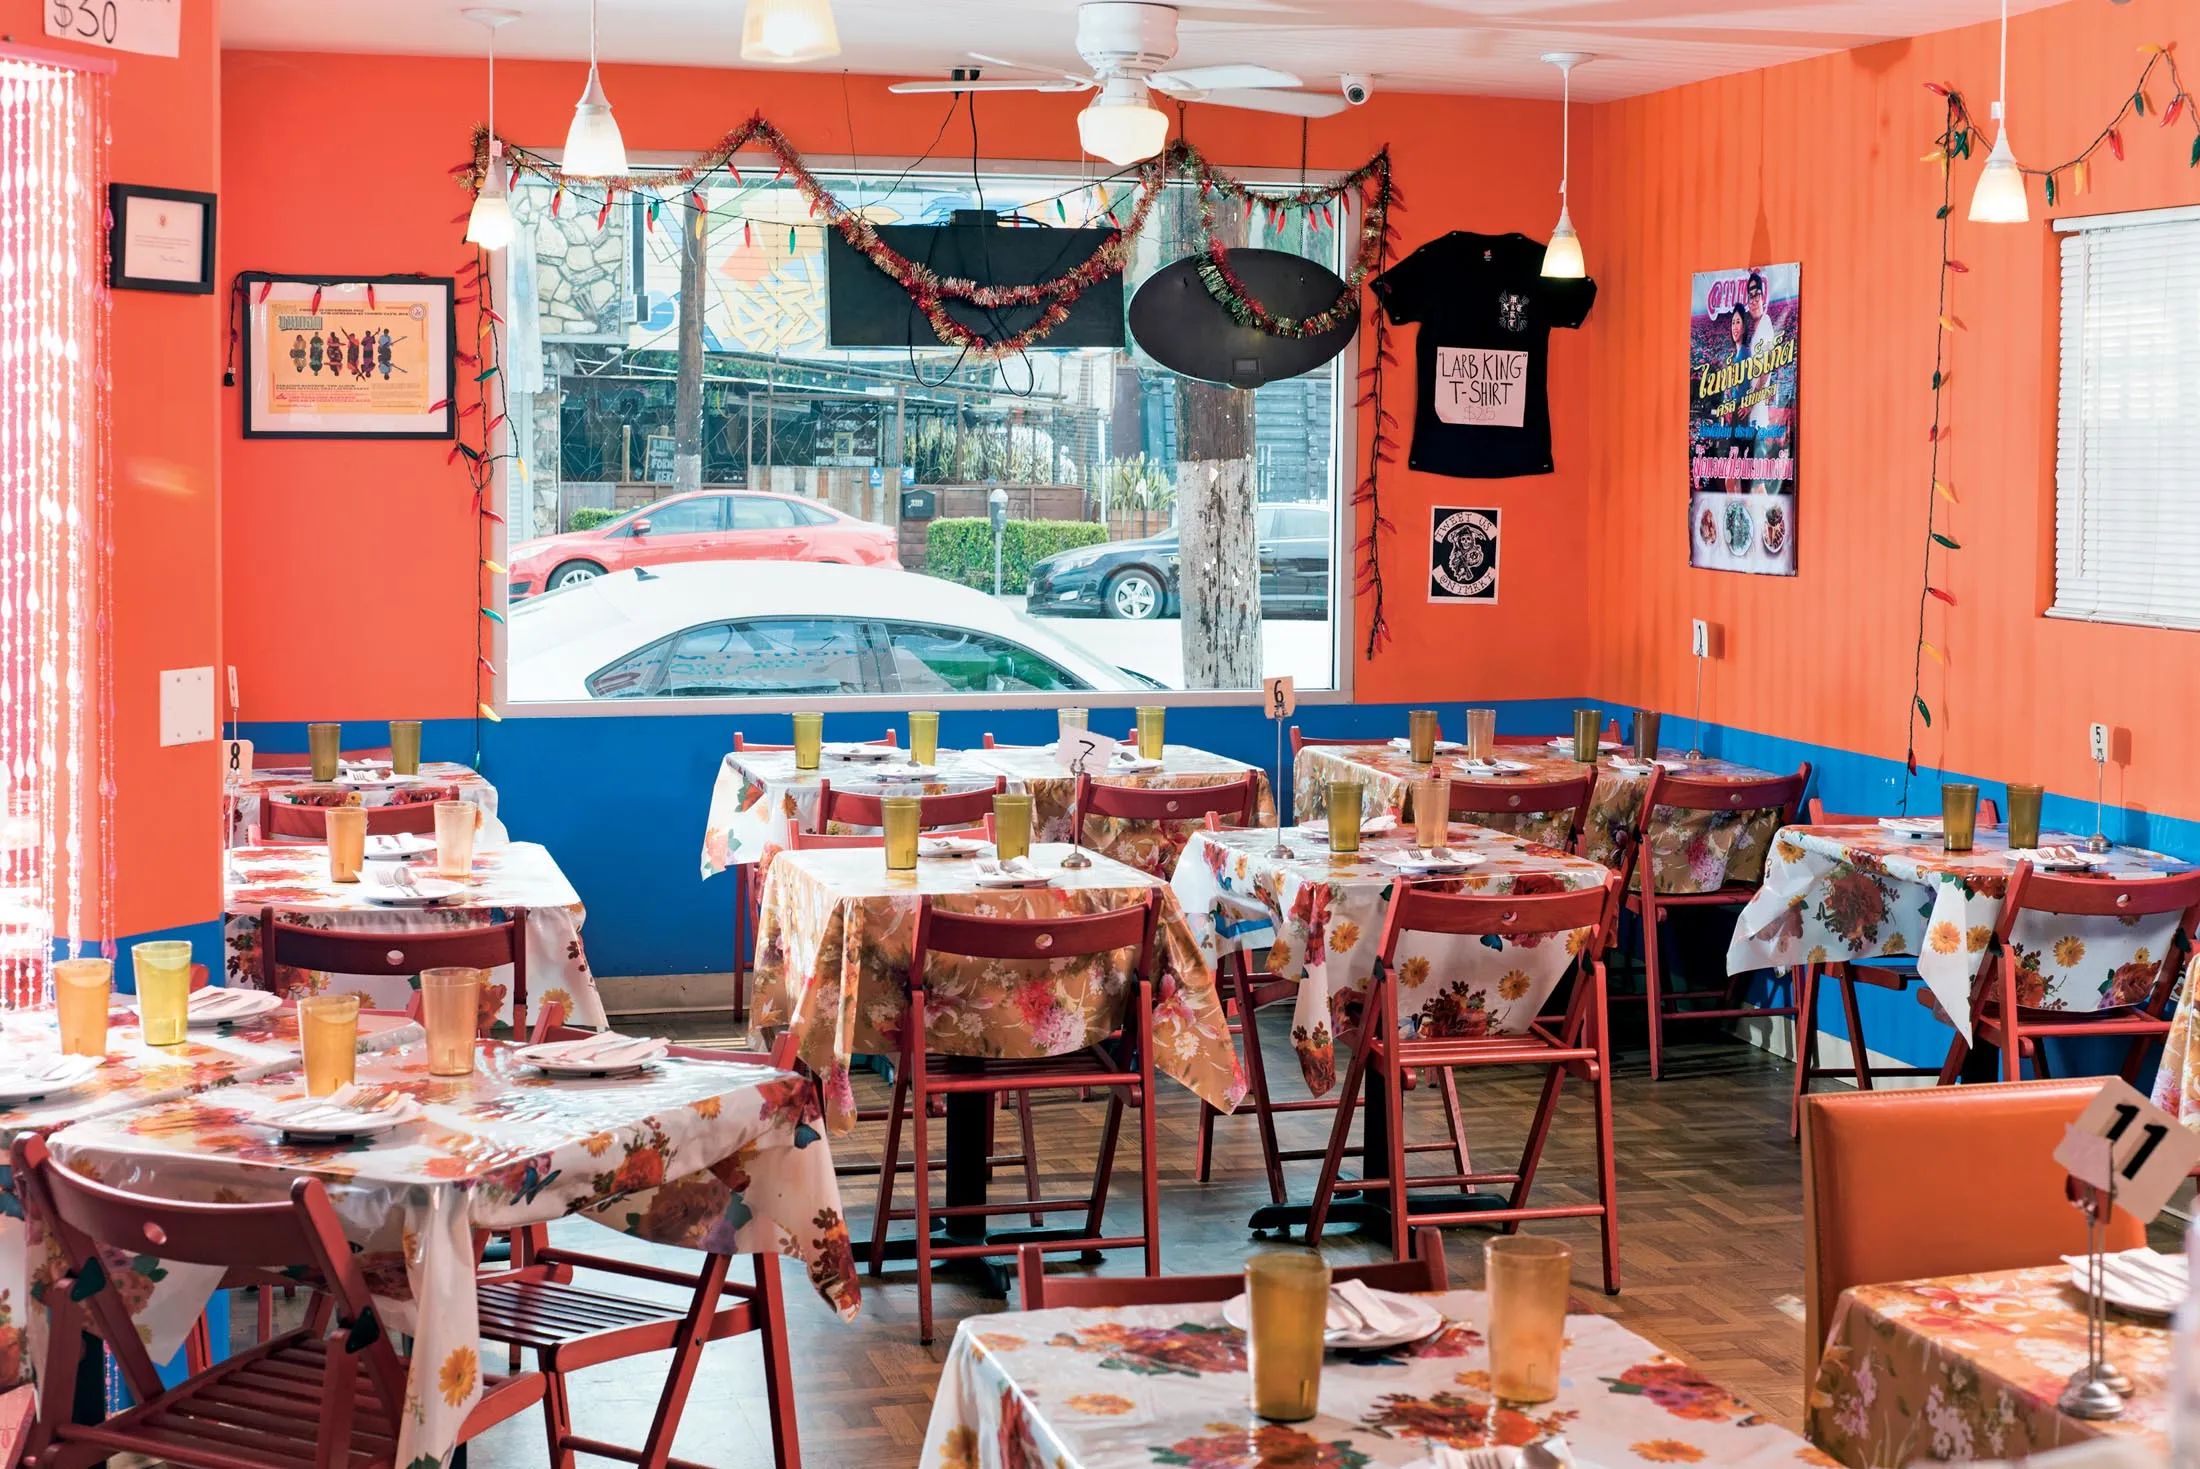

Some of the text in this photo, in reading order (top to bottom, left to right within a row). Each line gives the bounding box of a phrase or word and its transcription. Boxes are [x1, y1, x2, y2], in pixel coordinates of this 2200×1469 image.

[1449, 380, 1514, 407] T-SHIRT
[1436, 512, 1493, 538] TWEET US
[1440, 572, 1493, 595] @NTMRKT
[1273, 679, 1284, 703] 6
[2095, 726, 2102, 744] 5
[230, 742, 241, 771] 8
[1079, 739, 1096, 761] 7
[2104, 1103, 2169, 1181] 11
